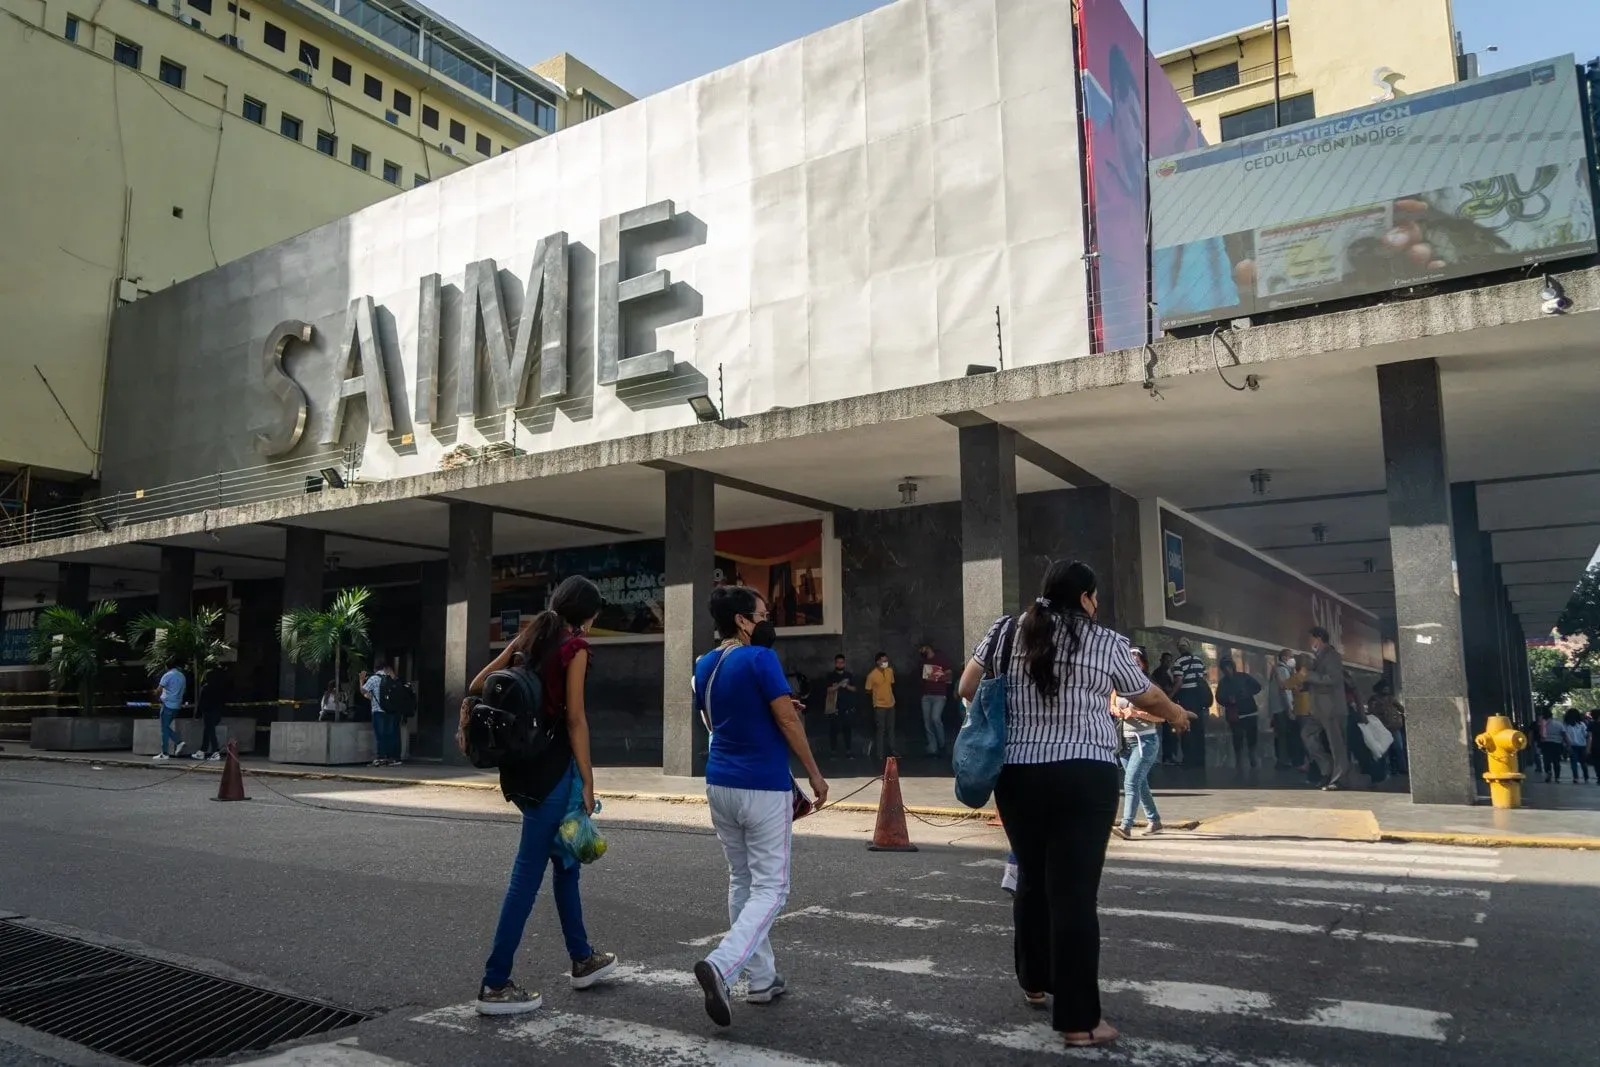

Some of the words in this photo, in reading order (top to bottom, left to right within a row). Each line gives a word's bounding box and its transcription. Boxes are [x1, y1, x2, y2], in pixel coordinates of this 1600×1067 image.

[1263, 104, 1411, 152] IDENTIFICACIÓN
[1244, 138, 1346, 172] CEDULACIÓN
[254, 199, 675, 457] SAIME
